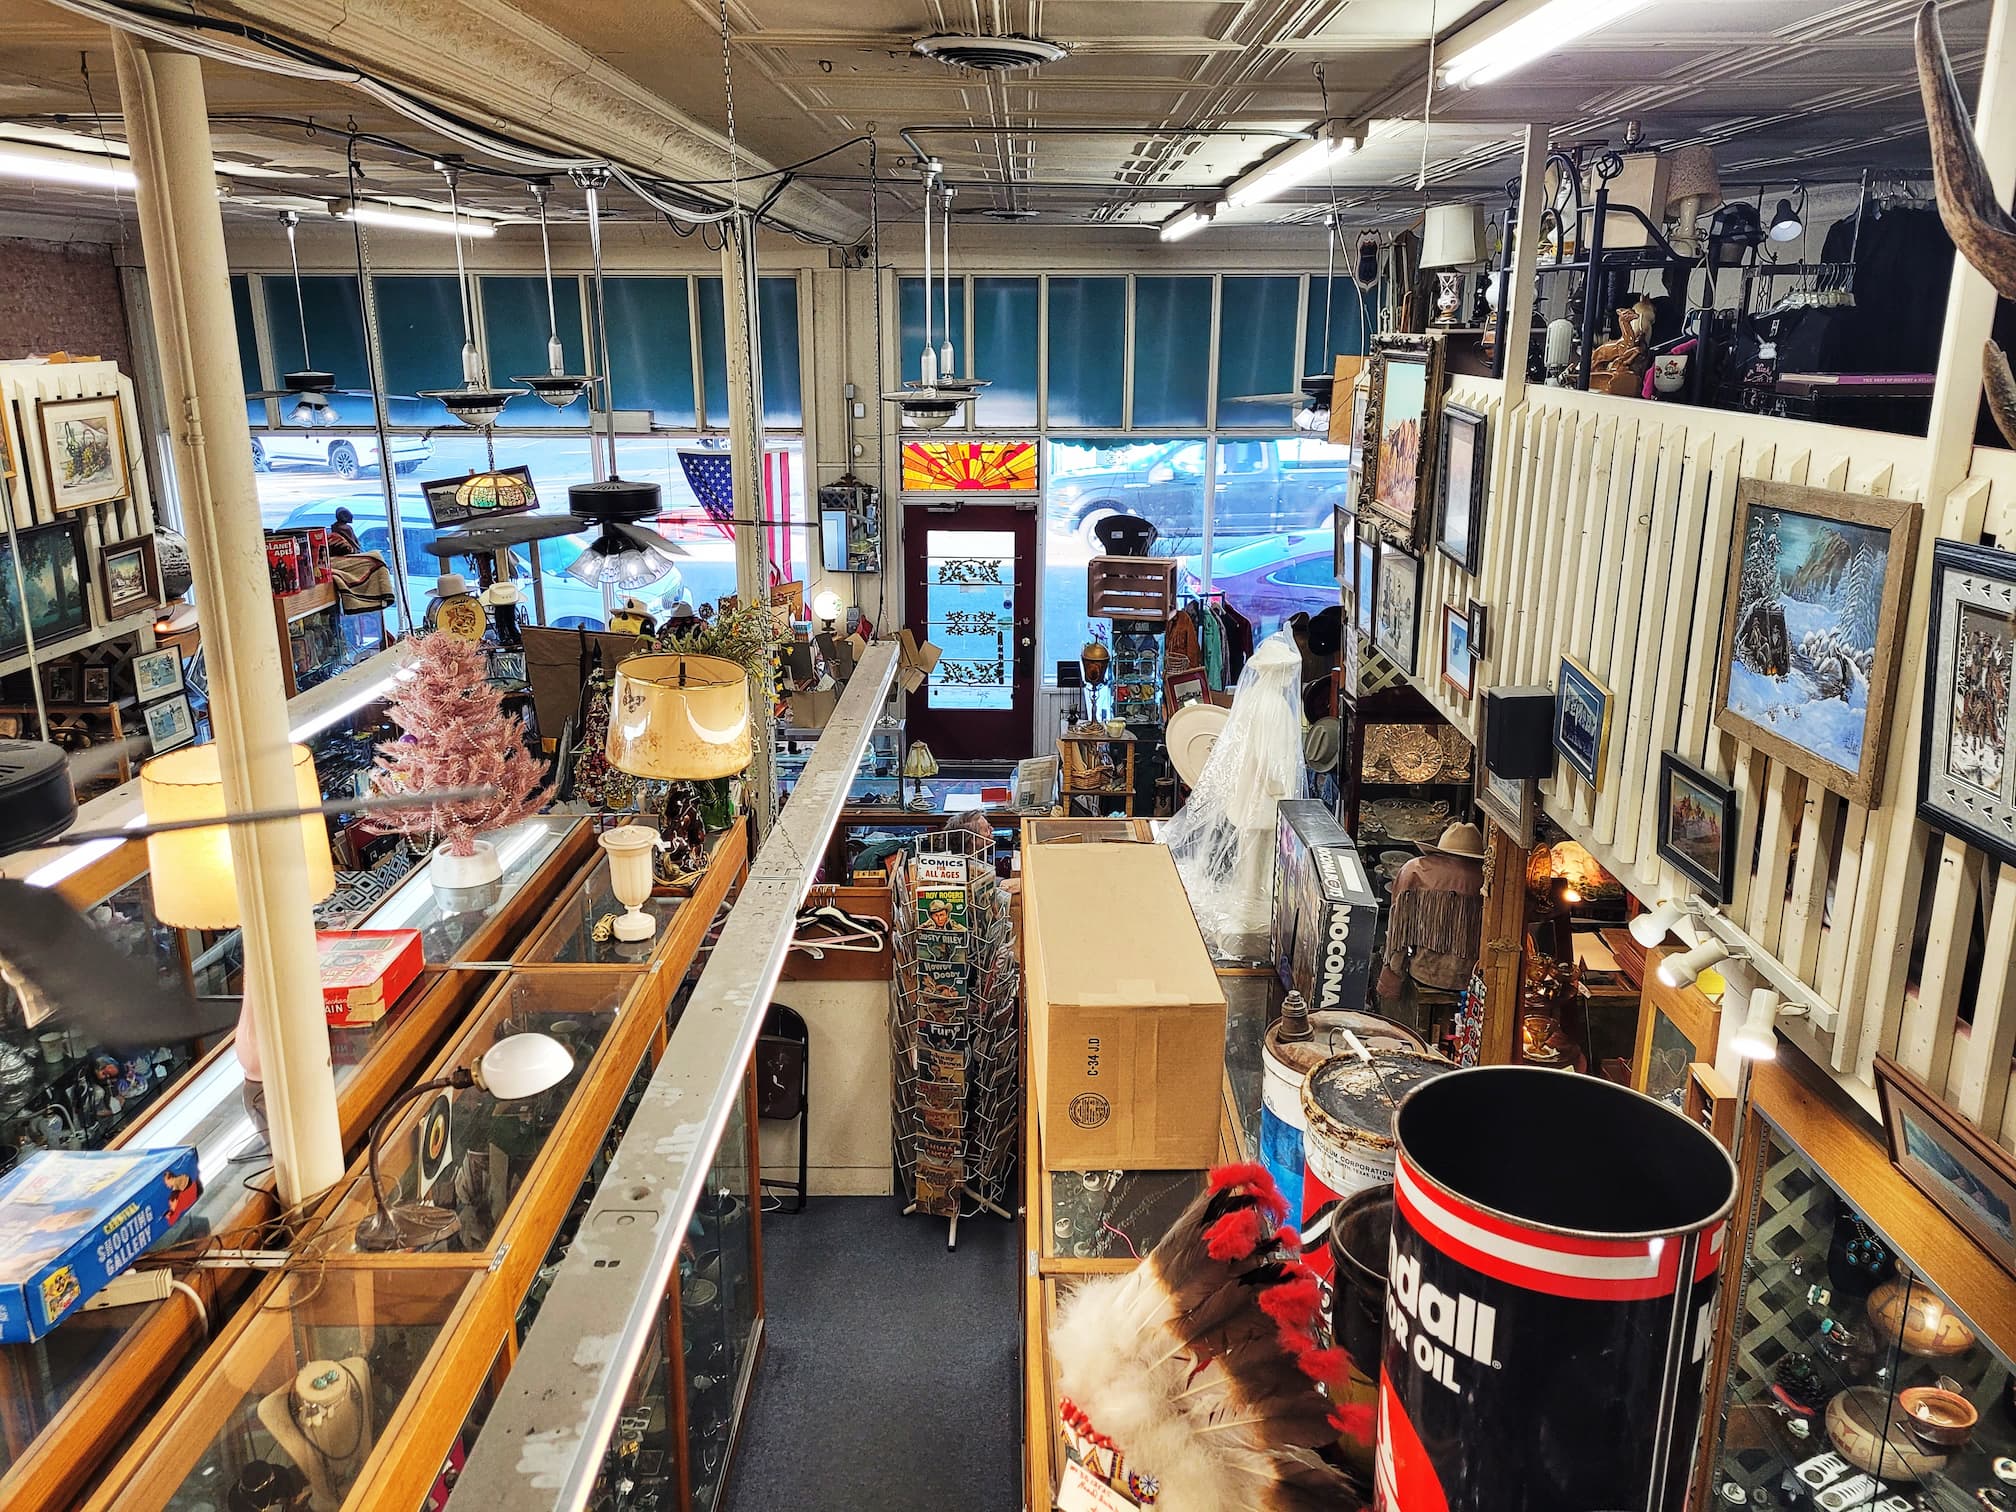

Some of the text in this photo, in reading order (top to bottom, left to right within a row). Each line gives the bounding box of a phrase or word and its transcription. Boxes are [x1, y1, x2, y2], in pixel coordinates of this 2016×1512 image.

[921, 858, 964, 867] COMICS
[925, 870, 960, 879] ALL AGES
[925, 891, 964, 900] ROY ROGERS
[1320, 903, 1352, 1008] NOCONA
[325, 1003, 343, 1014] AIN
[930, 1024, 959, 1040] Fury
[1087, 1054, 1100, 1076] C-34
[1340, 1155, 1394, 1178] CORPORATION
[97, 1205, 154, 1263] SHOOTING
[105, 1224, 151, 1277] GALLERY
[1387, 1280, 1461, 1394] OR OIL
